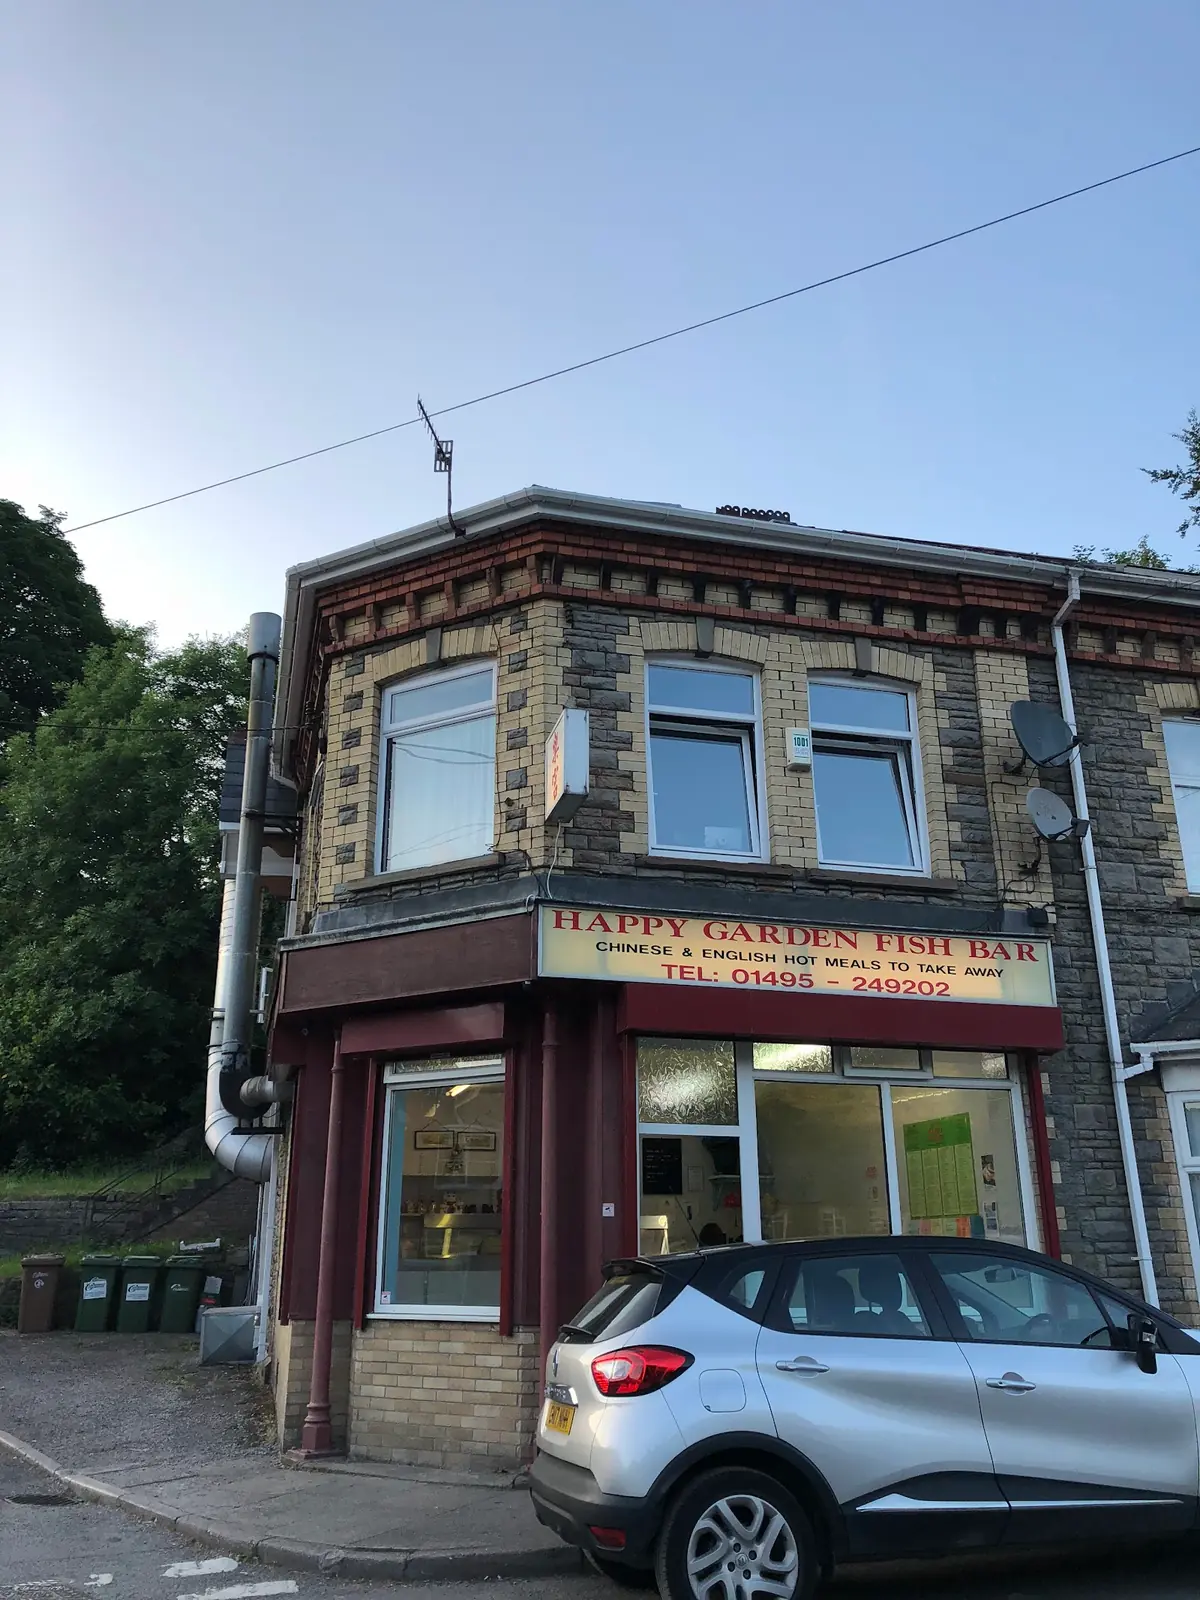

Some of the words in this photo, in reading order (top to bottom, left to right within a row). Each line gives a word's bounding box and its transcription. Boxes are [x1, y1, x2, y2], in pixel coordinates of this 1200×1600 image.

[552, 909, 689, 938] HAPPY
[703, 921, 860, 950] GARDEN
[873, 933, 954, 957] FISH
[968, 939, 1039, 962] BAR
[595, 941, 673, 956] CHINESE
[681, 947, 693, 957] &
[702, 948, 776, 963] ENGLISH
[784, 954, 818, 966] HOT
[825, 957, 881, 970] MEALS
[888, 961, 910, 972] TO
[917, 963, 957, 976] TAKE
[964, 967, 1004, 978] AWAY
[661, 963, 719, 982] TEL:
[731, 968, 814, 989] 01495
[852, 976, 951, 997] 249202
